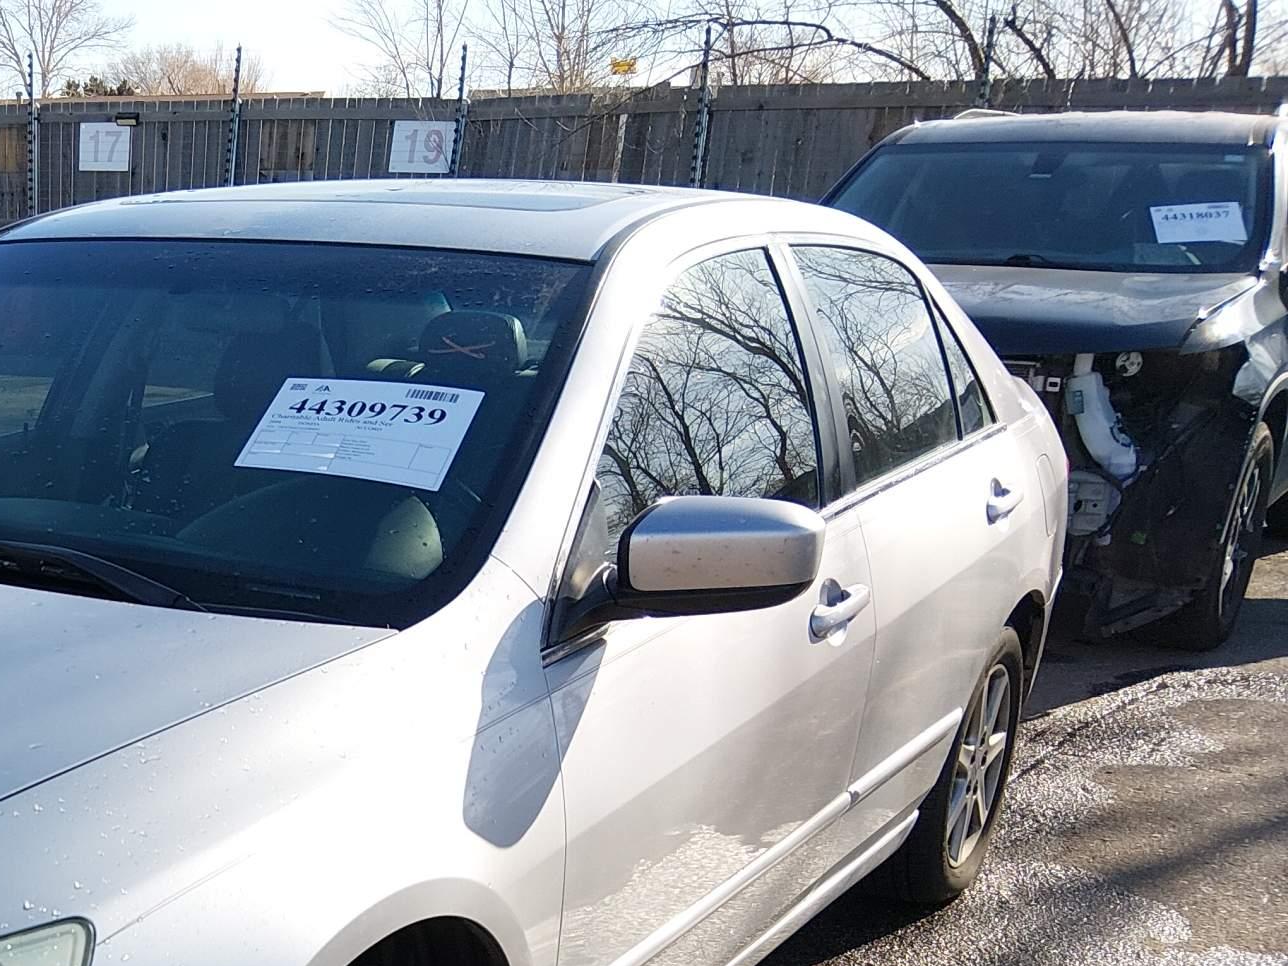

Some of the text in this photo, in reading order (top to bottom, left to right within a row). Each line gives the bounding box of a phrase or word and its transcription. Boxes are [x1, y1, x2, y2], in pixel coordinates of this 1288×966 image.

[89, 130, 122, 163] 17
[405, 129, 444, 164] 19
[289, 397, 447, 426] 44309739
